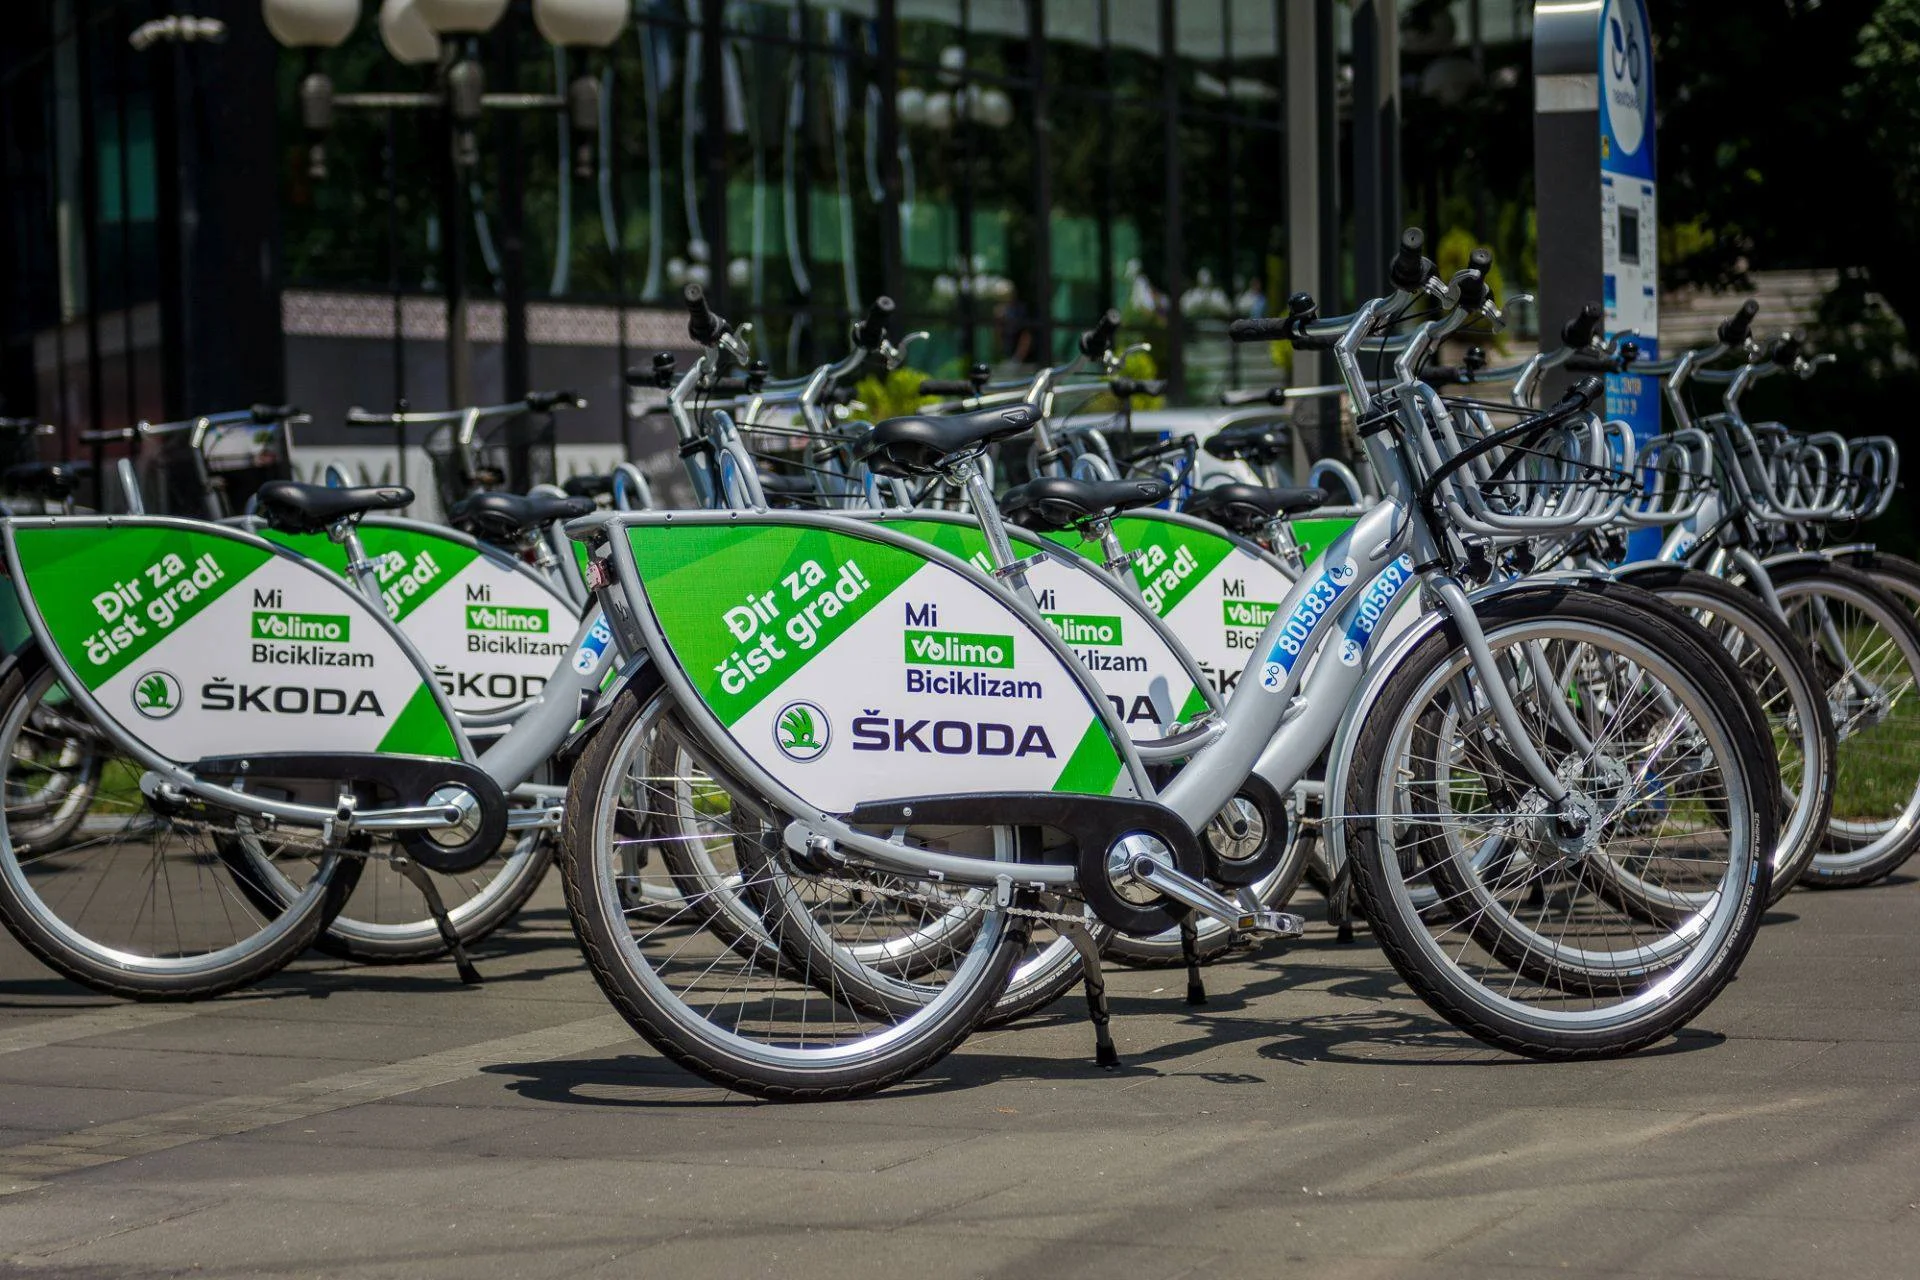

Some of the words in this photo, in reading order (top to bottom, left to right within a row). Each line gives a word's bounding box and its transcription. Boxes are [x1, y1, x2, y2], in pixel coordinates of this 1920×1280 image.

[1135, 544, 1168, 578] za
[1141, 543, 1199, 615] grad!
[81, 611, 147, 667] čist
[146, 551, 226, 637] grad!
[91, 580, 146, 625] Đir
[146, 552, 187, 591] za
[253, 588, 283, 609] Mi
[466, 583, 491, 602] Mi
[721, 587, 781, 645] Đir
[781, 558, 827, 601] za
[1222, 578, 1246, 598] Mi
[1355, 566, 1403, 634] 80589
[712, 638, 787, 696] čist
[785, 559, 872, 651] grad!
[905, 602, 937, 627] Mi
[1278, 579, 1337, 656] 80583
[251, 644, 375, 669] Biciklizam
[201, 676, 386, 718] ŠKODA
[906, 668, 1043, 699] Biciklizam
[851, 708, 1057, 759] ŠKODA
